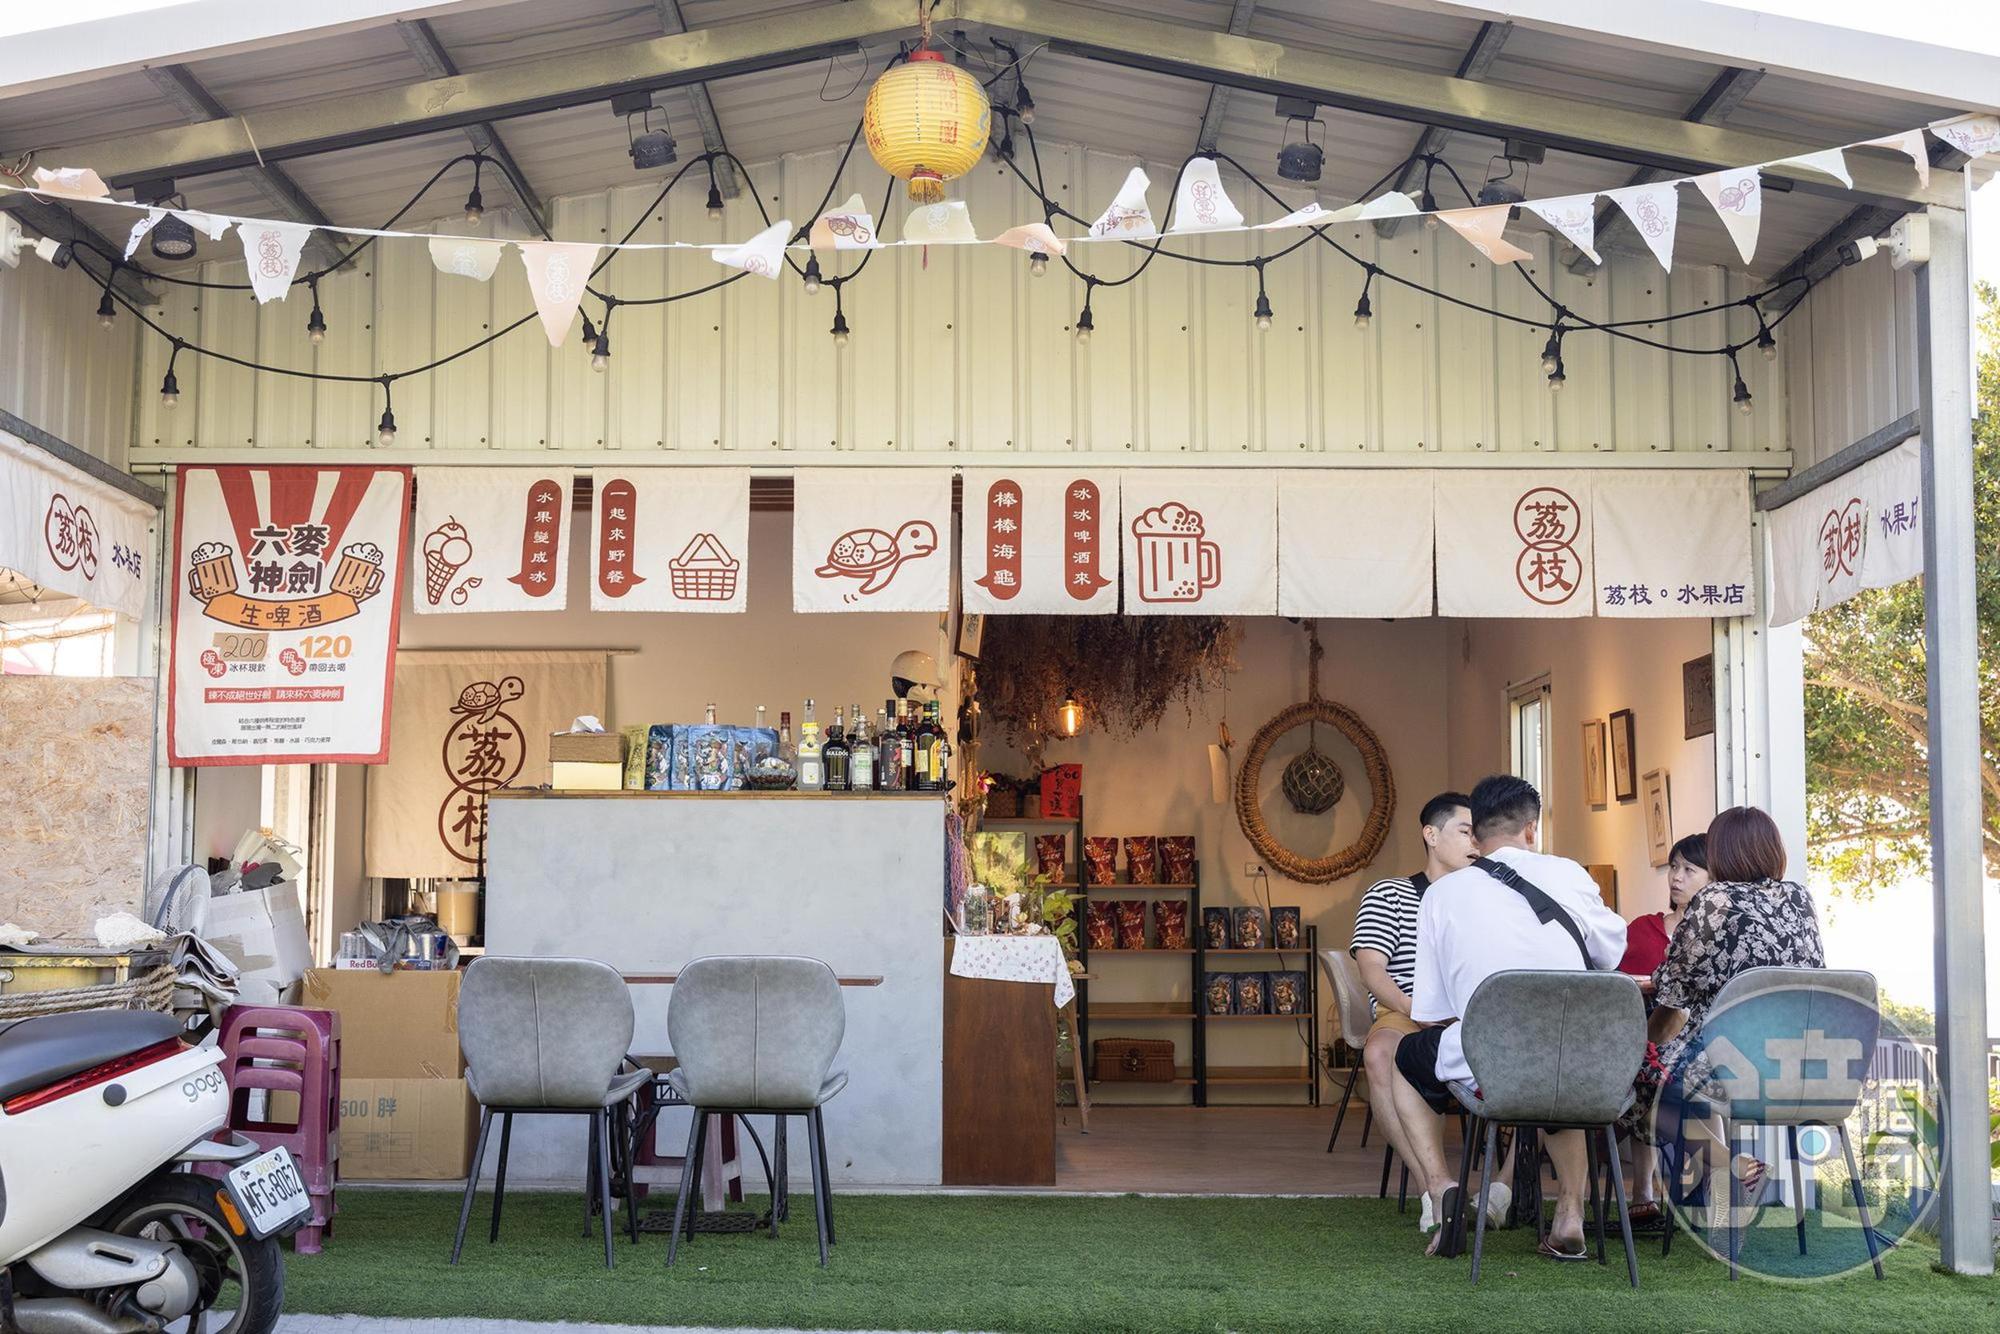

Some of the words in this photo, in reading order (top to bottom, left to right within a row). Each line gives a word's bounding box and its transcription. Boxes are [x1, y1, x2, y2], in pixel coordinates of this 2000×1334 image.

[252, 523, 329, 557] 六麥
[529, 491, 554, 584] 水果變成冰
[605, 491, 628, 585] 一起來野餐
[992, 491, 1018, 587] 棒棒海龜
[1072, 487, 1092, 586] 冰冰啤酒來
[1524, 500, 1573, 592] 荔枝
[249, 560, 323, 594] 神劍
[239, 603, 322, 628] 生啤酒
[222, 635, 266, 659] 200
[300, 636, 352, 659] 120
[350, 960, 365, 968] Red
[377, 1097, 398, 1118] 胖
[240, 1164, 304, 1218] MFG-8052
